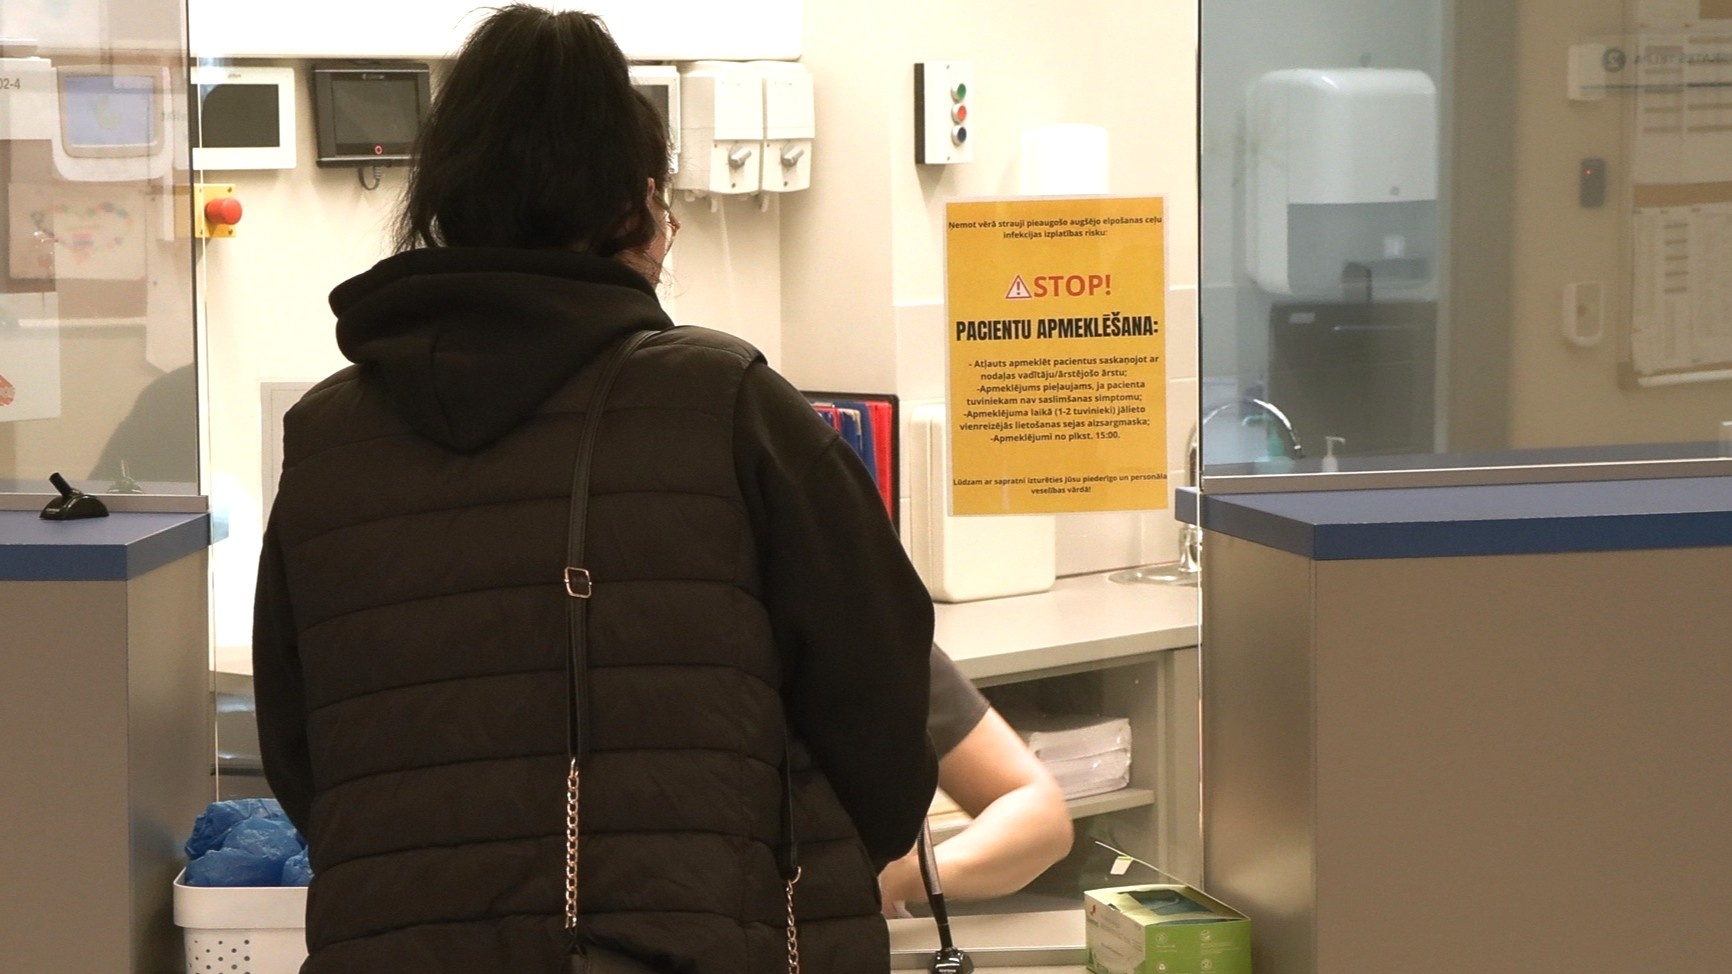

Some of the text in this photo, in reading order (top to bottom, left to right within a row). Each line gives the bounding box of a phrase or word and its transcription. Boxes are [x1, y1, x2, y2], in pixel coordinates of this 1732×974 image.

[998, 220, 1025, 229] strauji
[1027, 218, 1068, 228] pieaugošo
[1070, 218, 1101, 227] augšējo
[1103, 217, 1143, 226] elpošanas
[1145, 216, 1162, 225] ceļu
[1003, 231, 1042, 239] infekcijas
[1044, 229, 1083, 239] izplatības
[1034, 274, 1111, 298] STOP!
[956, 311, 1158, 341] PACIENTU APMEKLĒŠANA:
[974, 360, 1007, 369] Atļauts
[1009, 358, 1051, 368] apmeklēt
[1053, 357, 1097, 367] pacientus
[1099, 355, 1147, 365] saskaņojot
[981, 369, 1127, 381] nodaļas vadītāju/ārstējošo ārstu;
[977, 384, 1041, 394] -Apmeklējums
[1043, 382, 1094, 392] pieļaujams,
[1107, 381, 1145, 391] pacienta
[966, 397, 1018, 406] tuviniekam
[1038, 394, 1092, 404] saslimšanas
[1095, 393, 1142, 403] simptomu;
[963, 406, 1145, 419] -Apmeklējuma laikā (1-2 tuvinieki) jālieto
[960, 418, 1150, 431] vienreizējās lietošanas sejas aizsargmaska;
[990, 433, 1052, 443] -Apmeklējumi
[1068, 432, 1093, 442] plkst.
[1096, 431, 1120, 439] 15:00.
[994, 477, 1025, 486] sapratni
[1027, 476, 1063, 484] izturēties
[1083, 474, 1117, 483] piederīgo
[1130, 473, 1167, 482] personāla
[1031, 486, 1065, 494] veselības
